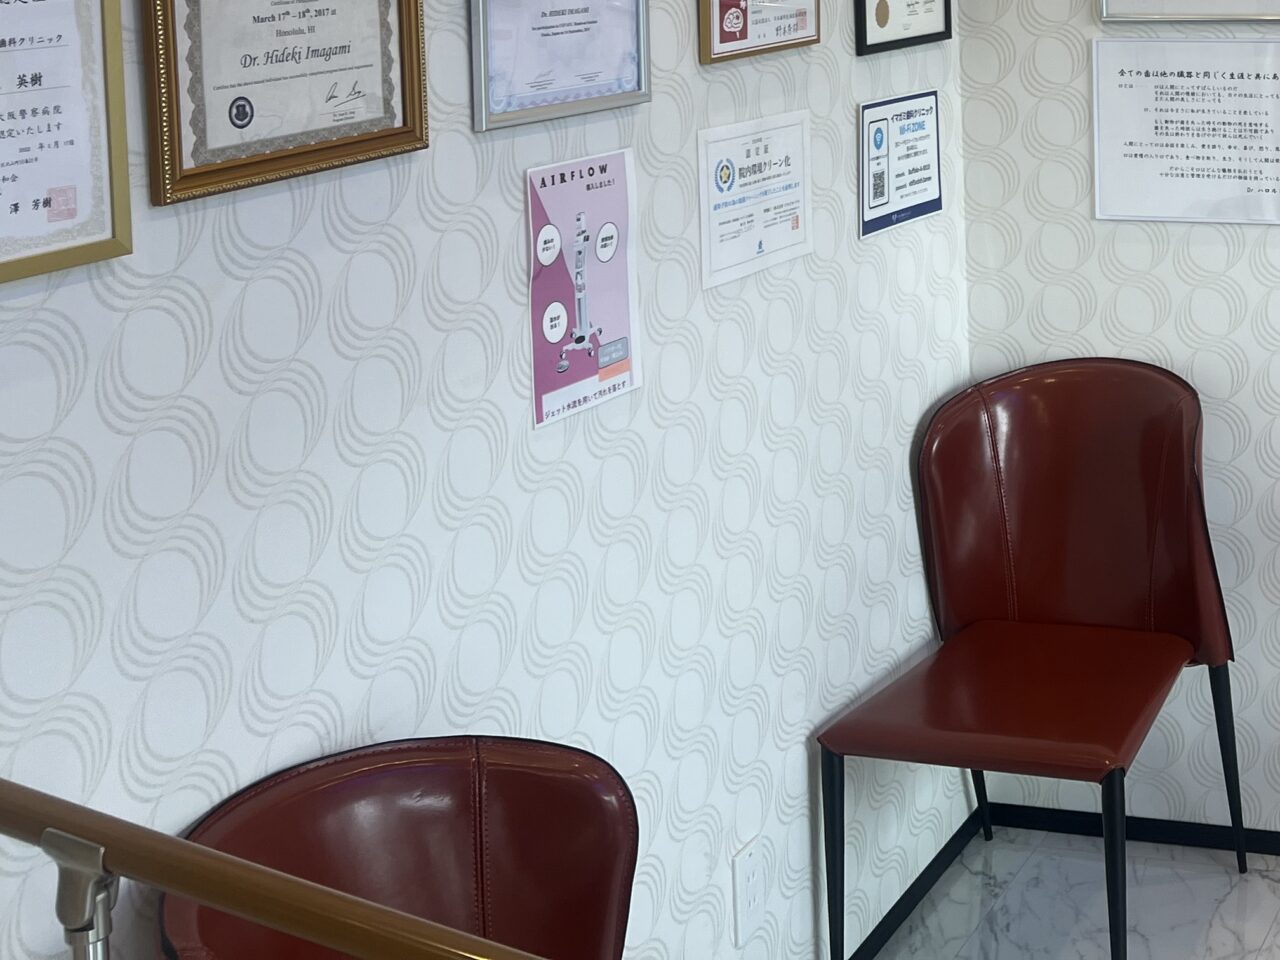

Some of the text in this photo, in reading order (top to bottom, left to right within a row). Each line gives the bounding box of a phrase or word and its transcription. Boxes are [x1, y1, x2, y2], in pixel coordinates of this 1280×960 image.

[252, 14, 276, 25] March
[314, 8, 330, 18] 2017
[240, 41, 352, 69] Dr. Hideki Imagami
[16, 72, 43, 89] 英樹
[539, 163, 608, 189] AIRFLOW
